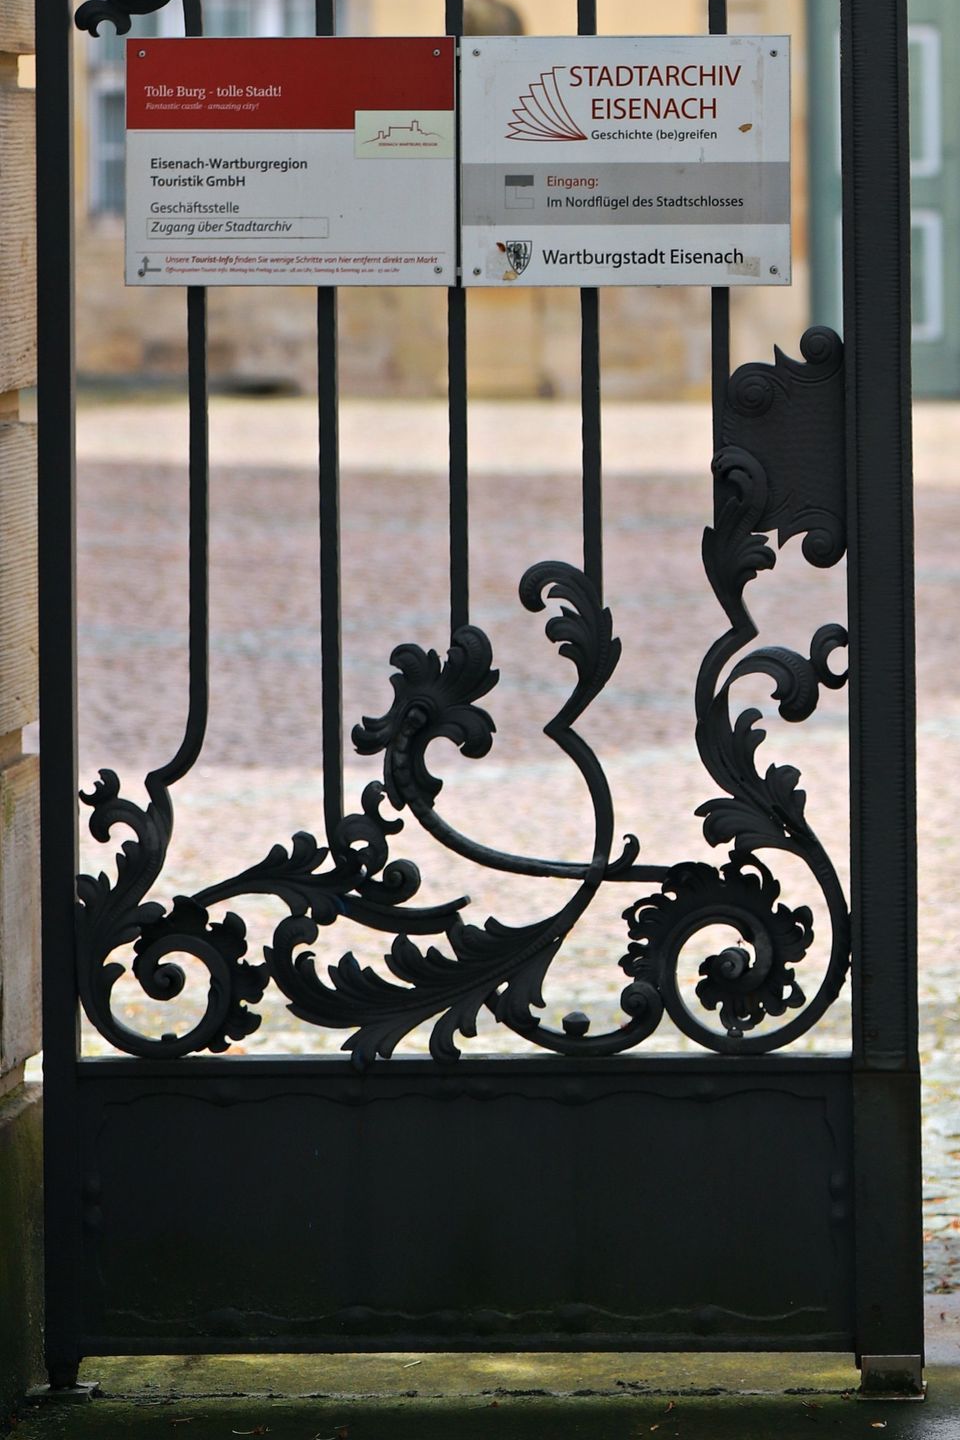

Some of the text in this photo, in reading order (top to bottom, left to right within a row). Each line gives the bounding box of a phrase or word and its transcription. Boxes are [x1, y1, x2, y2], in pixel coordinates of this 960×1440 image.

[569, 65, 741, 87] STADTARCHIV
[144, 85, 173, 97] Tolle
[176, 85, 206, 100] Burg
[216, 85, 243, 97] tolle
[245, 85, 282, 97] Stadt!
[591, 97, 717, 120] EISENACH
[591, 130, 718, 142] Geschichte (be)greifen
[150, 157, 308, 172] Eisenach-Wartburgregion
[150, 175, 246, 187] Touristik GmbH
[547, 176, 599, 189] Eingang:
[150, 202, 240, 214] Geschäftsstelle
[547, 196, 744, 209] Im Nordflügel des Stadtschlosses
[151, 220, 292, 236] Zugang über Stadtarchiv
[191, 256, 233, 265] Tourist-Info
[542, 248, 744, 268] Wartburgstadt Eisenach
